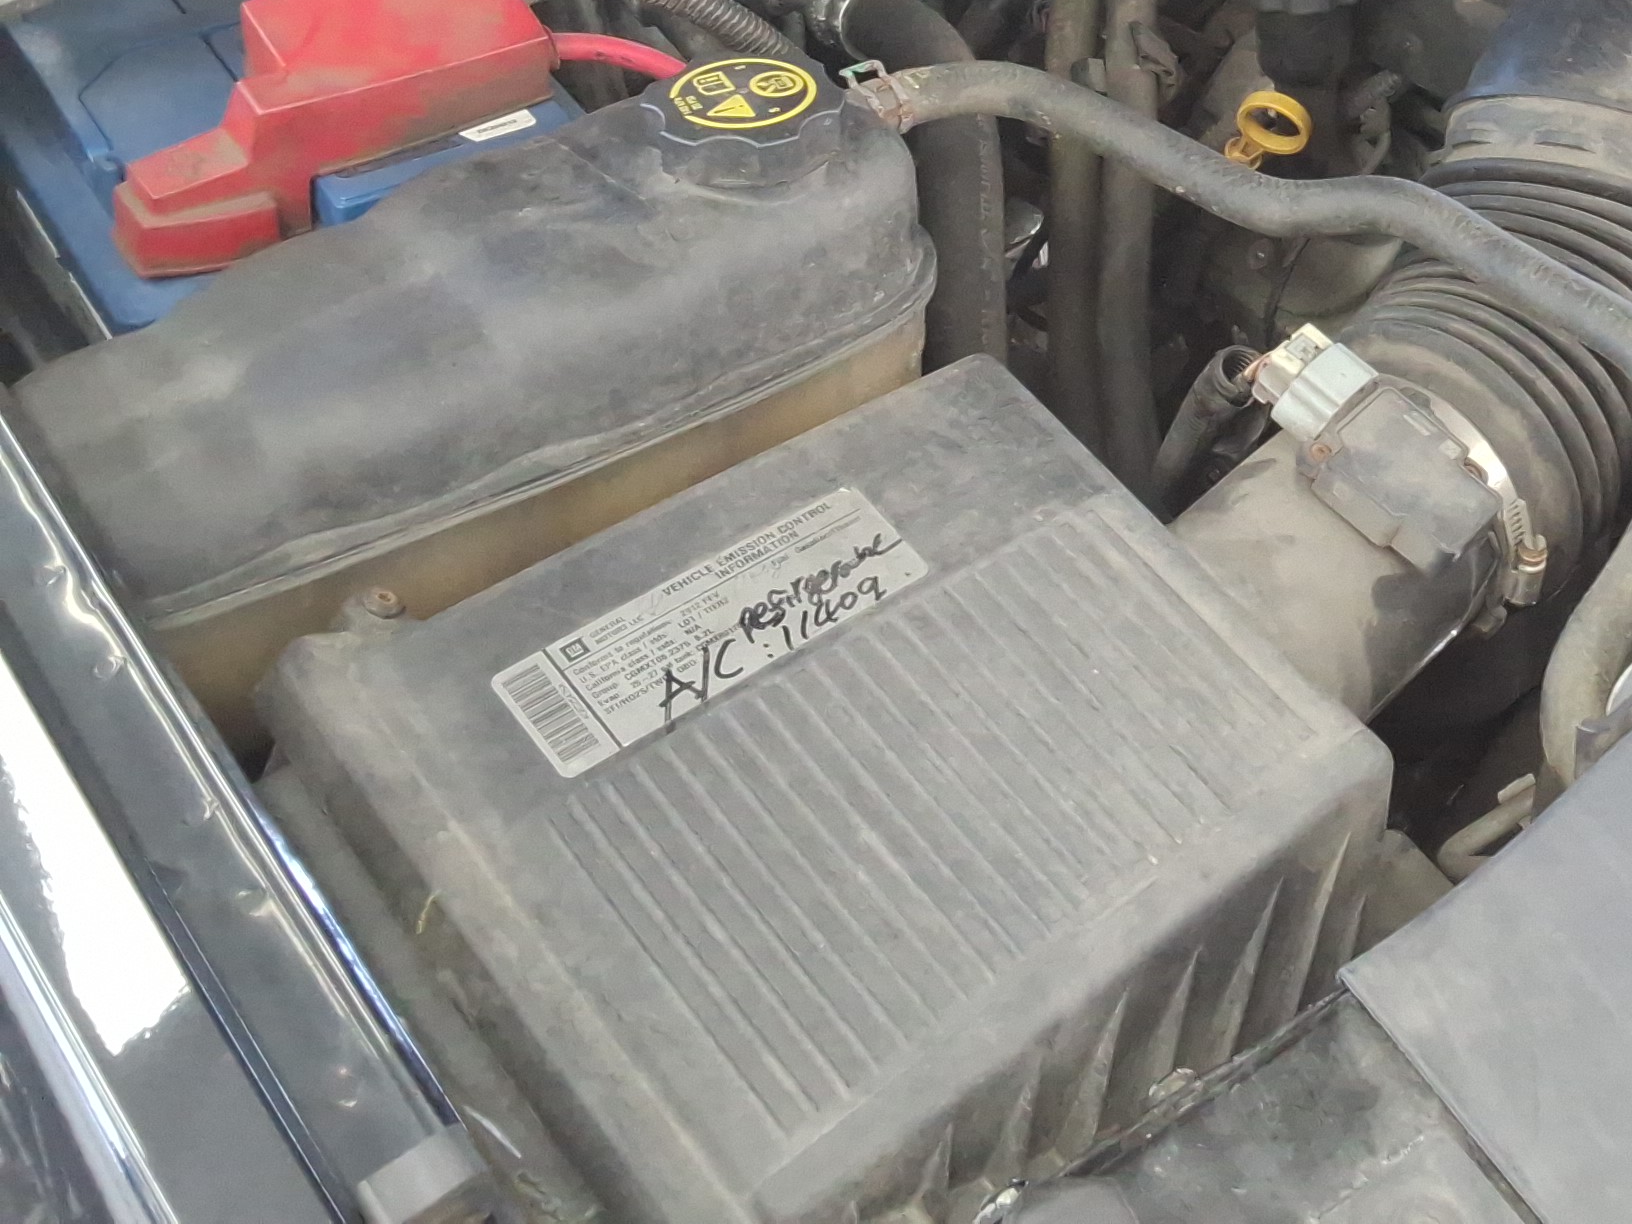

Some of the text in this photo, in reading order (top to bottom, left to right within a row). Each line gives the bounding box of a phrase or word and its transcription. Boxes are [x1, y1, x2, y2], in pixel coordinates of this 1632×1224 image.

[663, 502, 830, 595] VEHICLE EMISSION CONTROL
[715, 531, 798, 579] INFORMATION
[586, 666, 625, 691] California
[628, 654, 648, 668] class
[684, 624, 701, 635] N/A
[589, 617, 624, 638] GENERAL
[659, 639, 743, 734] A/C
